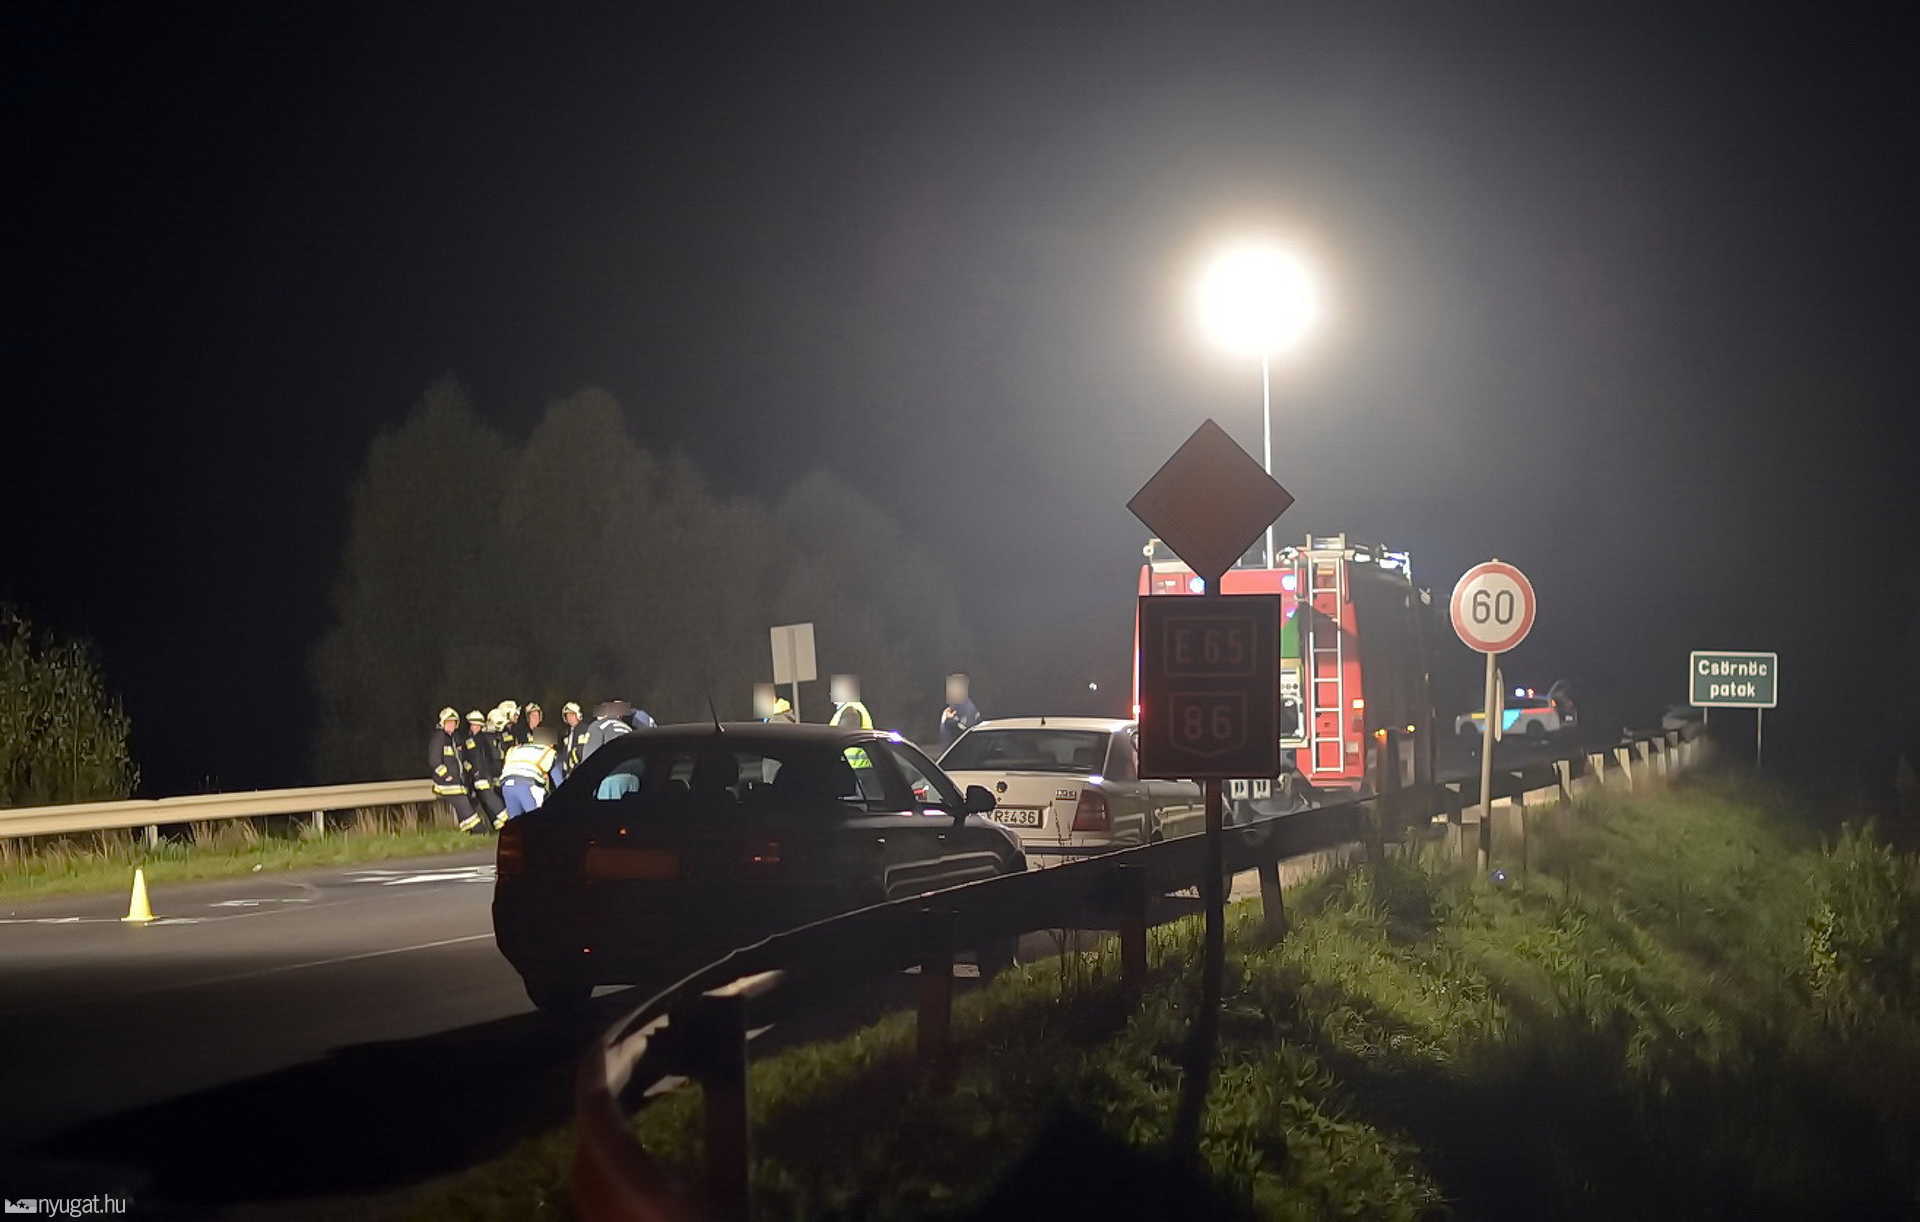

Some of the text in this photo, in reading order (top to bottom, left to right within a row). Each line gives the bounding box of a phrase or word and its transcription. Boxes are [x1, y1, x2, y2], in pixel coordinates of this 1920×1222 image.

[1472, 589, 1514, 625] 60
[1175, 629, 1244, 665] E 65
[1710, 681, 1756, 700] patak
[1183, 704, 1233, 740] 86
